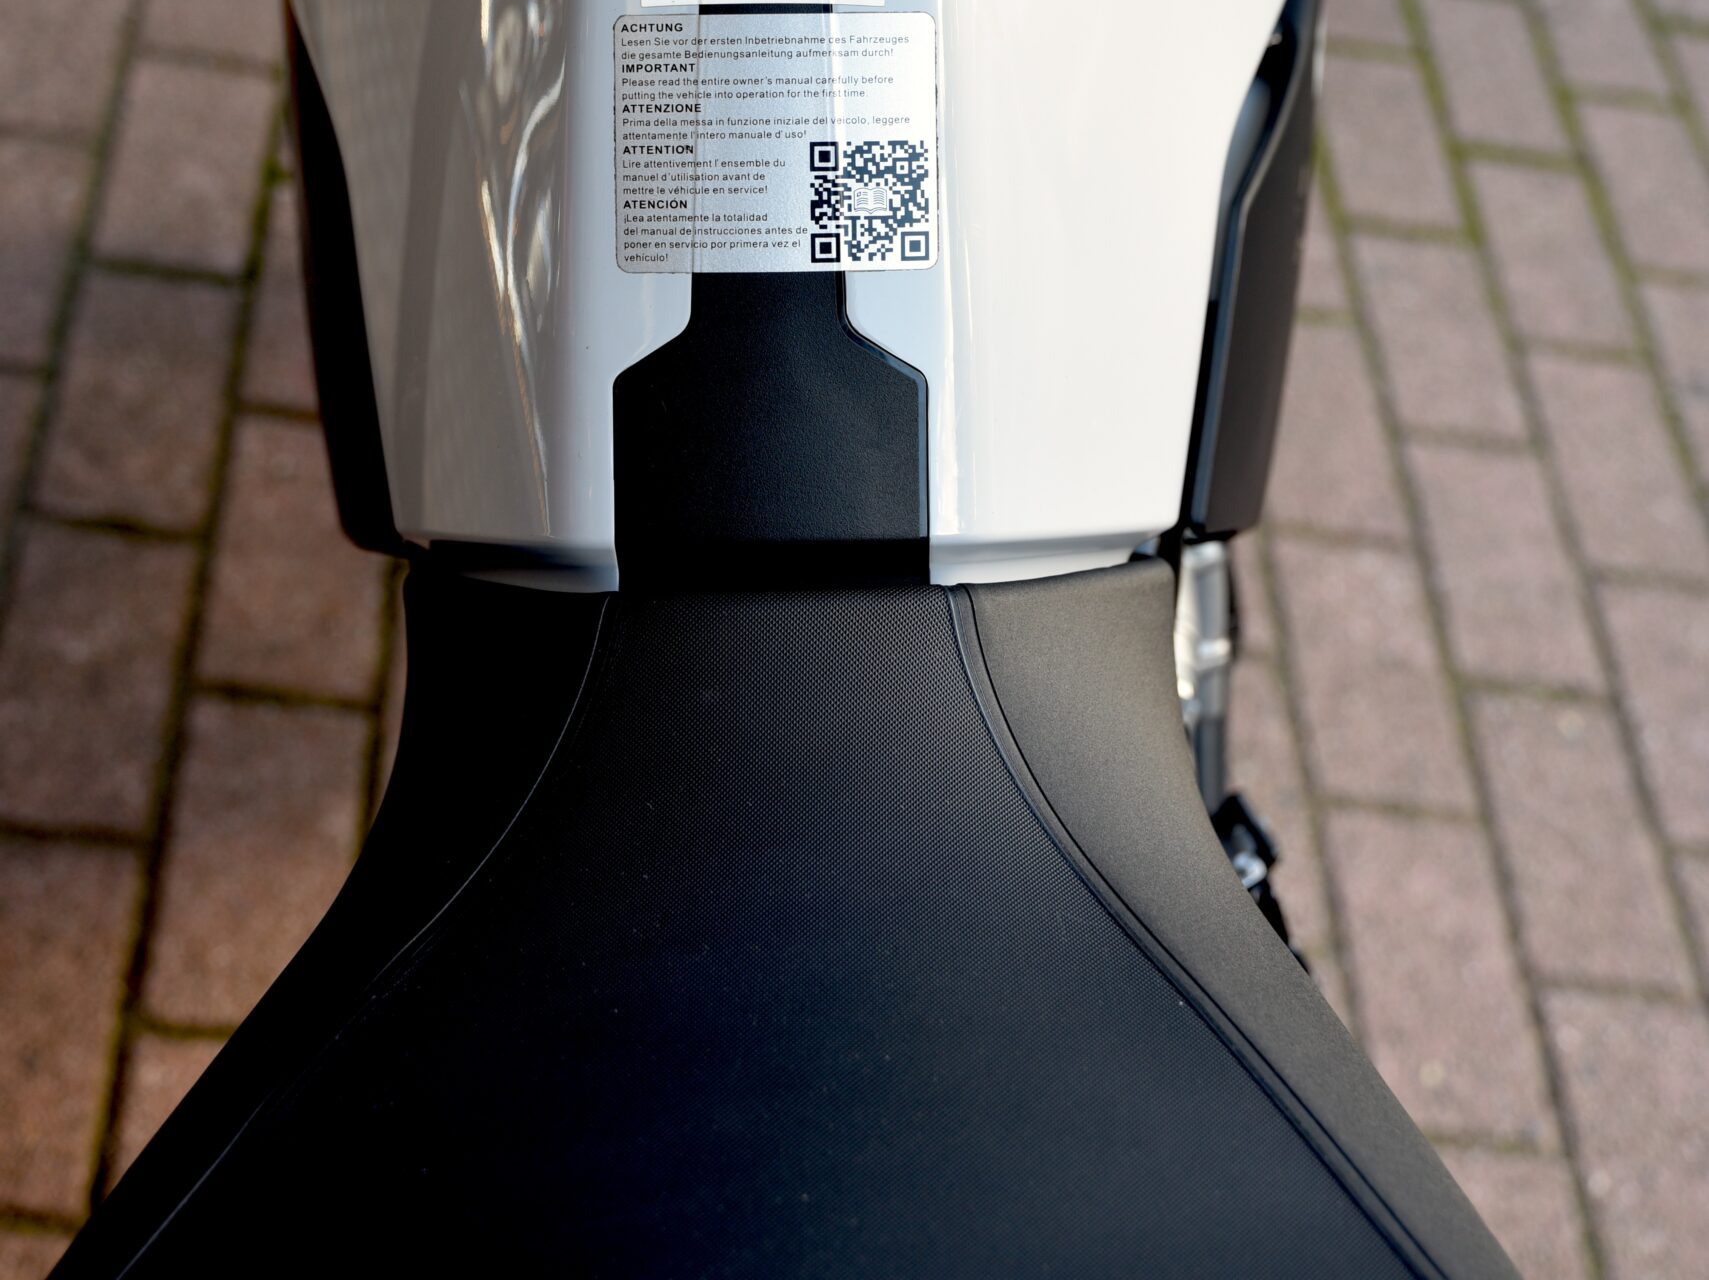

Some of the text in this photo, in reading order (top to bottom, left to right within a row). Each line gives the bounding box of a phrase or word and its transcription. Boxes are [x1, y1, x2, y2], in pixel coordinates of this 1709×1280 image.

[621, 23, 683, 33] ACHTUNG
[621, 38, 651, 47] Lesen
[654, 37, 670, 46] Sie
[691, 37, 708, 45] der
[710, 37, 742, 45] ersten
[745, 36, 825, 44] Inbetriebnahme
[849, 35, 909, 45] Fahrzeuges
[621, 50, 636, 60] die
[638, 51, 682, 61] gesamte
[684, 49, 793, 60] Bedienungsanleitung
[861, 48, 894, 57] durch!
[622, 63, 696, 73] IMPORTANT
[622, 75, 894, 87] Please read the entire owner's manual carefully before
[622, 90, 655, 101] putting
[658, 91, 674, 99] the
[676, 90, 712, 99] vehicle
[714, 91, 734, 99] into
[736, 90, 784, 100] operation
[787, 90, 800, 98] for
[803, 89, 820, 98] the
[822, 89, 842, 98] first
[622, 104, 702, 113] ATTENZIONE
[622, 118, 651, 127] Prima
[654, 118, 677, 126] della
[715, 117, 725, 126] in
[727, 117, 771, 126] funzione
[773, 117, 810, 125] iniziale
[812, 116, 828, 125] del
[872, 115, 910, 126] leggere
[622, 131, 688, 140] attentamente
[728, 130, 772, 139] manuale
[623, 145, 694, 155] ATTENTION
[623, 159, 642, 168] Lire
[644, 160, 712, 168] attentivement
[773, 159, 786, 168] du
[623, 173, 659, 182] manuel
[722, 173, 751, 181] avant
[753, 172, 765, 181] de
[623, 185, 768, 195] mettre le véhicule en service!
[623, 199, 688, 209] ATENCIÓN
[647, 214, 709, 222] atentamente
[712, 214, 721, 222] la
[723, 213, 768, 222] totalidad
[624, 226, 808, 236] del manual de instrucciones antes de
[624, 241, 652, 250] poner
[669, 239, 708, 249] servicio
[710, 240, 727, 250] por
[729, 239, 769, 249] primera
[772, 239, 789, 248] vez
[792, 239, 801, 248] el
